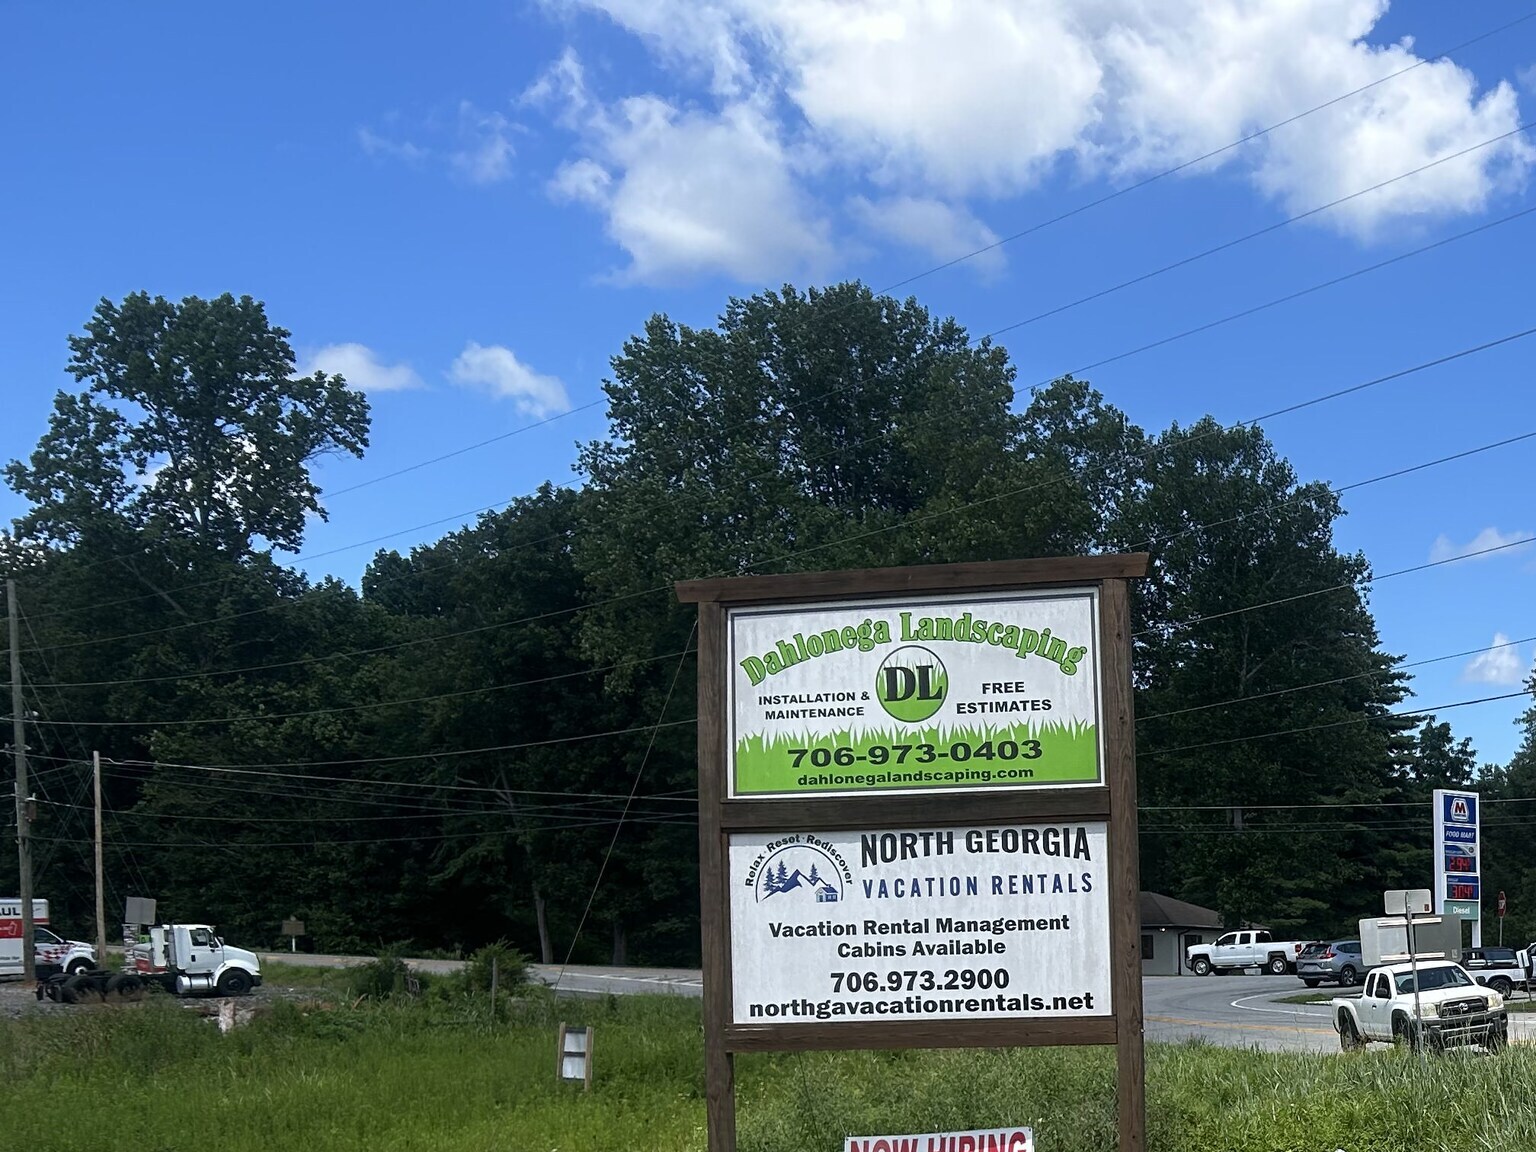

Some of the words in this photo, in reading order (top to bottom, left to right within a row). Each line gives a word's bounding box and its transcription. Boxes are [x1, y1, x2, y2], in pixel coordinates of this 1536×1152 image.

[739, 617, 891, 687] Dahlonega
[899, 611, 1088, 676] Landscaping
[883, 664, 943, 702] DL
[981, 681, 1025, 695] FREE
[758, 692, 856, 706] INSTALLATION
[861, 691, 871, 702] &
[956, 699, 1052, 715] ESTIMATES
[765, 706, 865, 720] MAINTENANCE
[787, 739, 1043, 769] 706-973-0403
[797, 766, 1034, 786] dahlonegalandscaping.com
[1446, 830, 1459, 838] FOOD
[1461, 830, 1475, 839] MART
[861, 828, 954, 867] NORTH
[964, 827, 1092, 861] GEORGIA
[745, 853, 765, 886] Relax
[806, 834, 853, 885] Rediscover
[862, 876, 979, 899] VACATION
[991, 872, 1092, 896] RENTALS
[1452, 906, 1470, 914] Diesel
[769, 921, 858, 938] Vacation
[864, 918, 930, 936] Rental
[936, 914, 1070, 934] Management
[837, 941, 907, 958] Cabins
[912, 939, 1006, 957] Available
[830, 968, 1010, 993] 706.973.2900
[749, 992, 1094, 1019] northgavacationrentals.net
